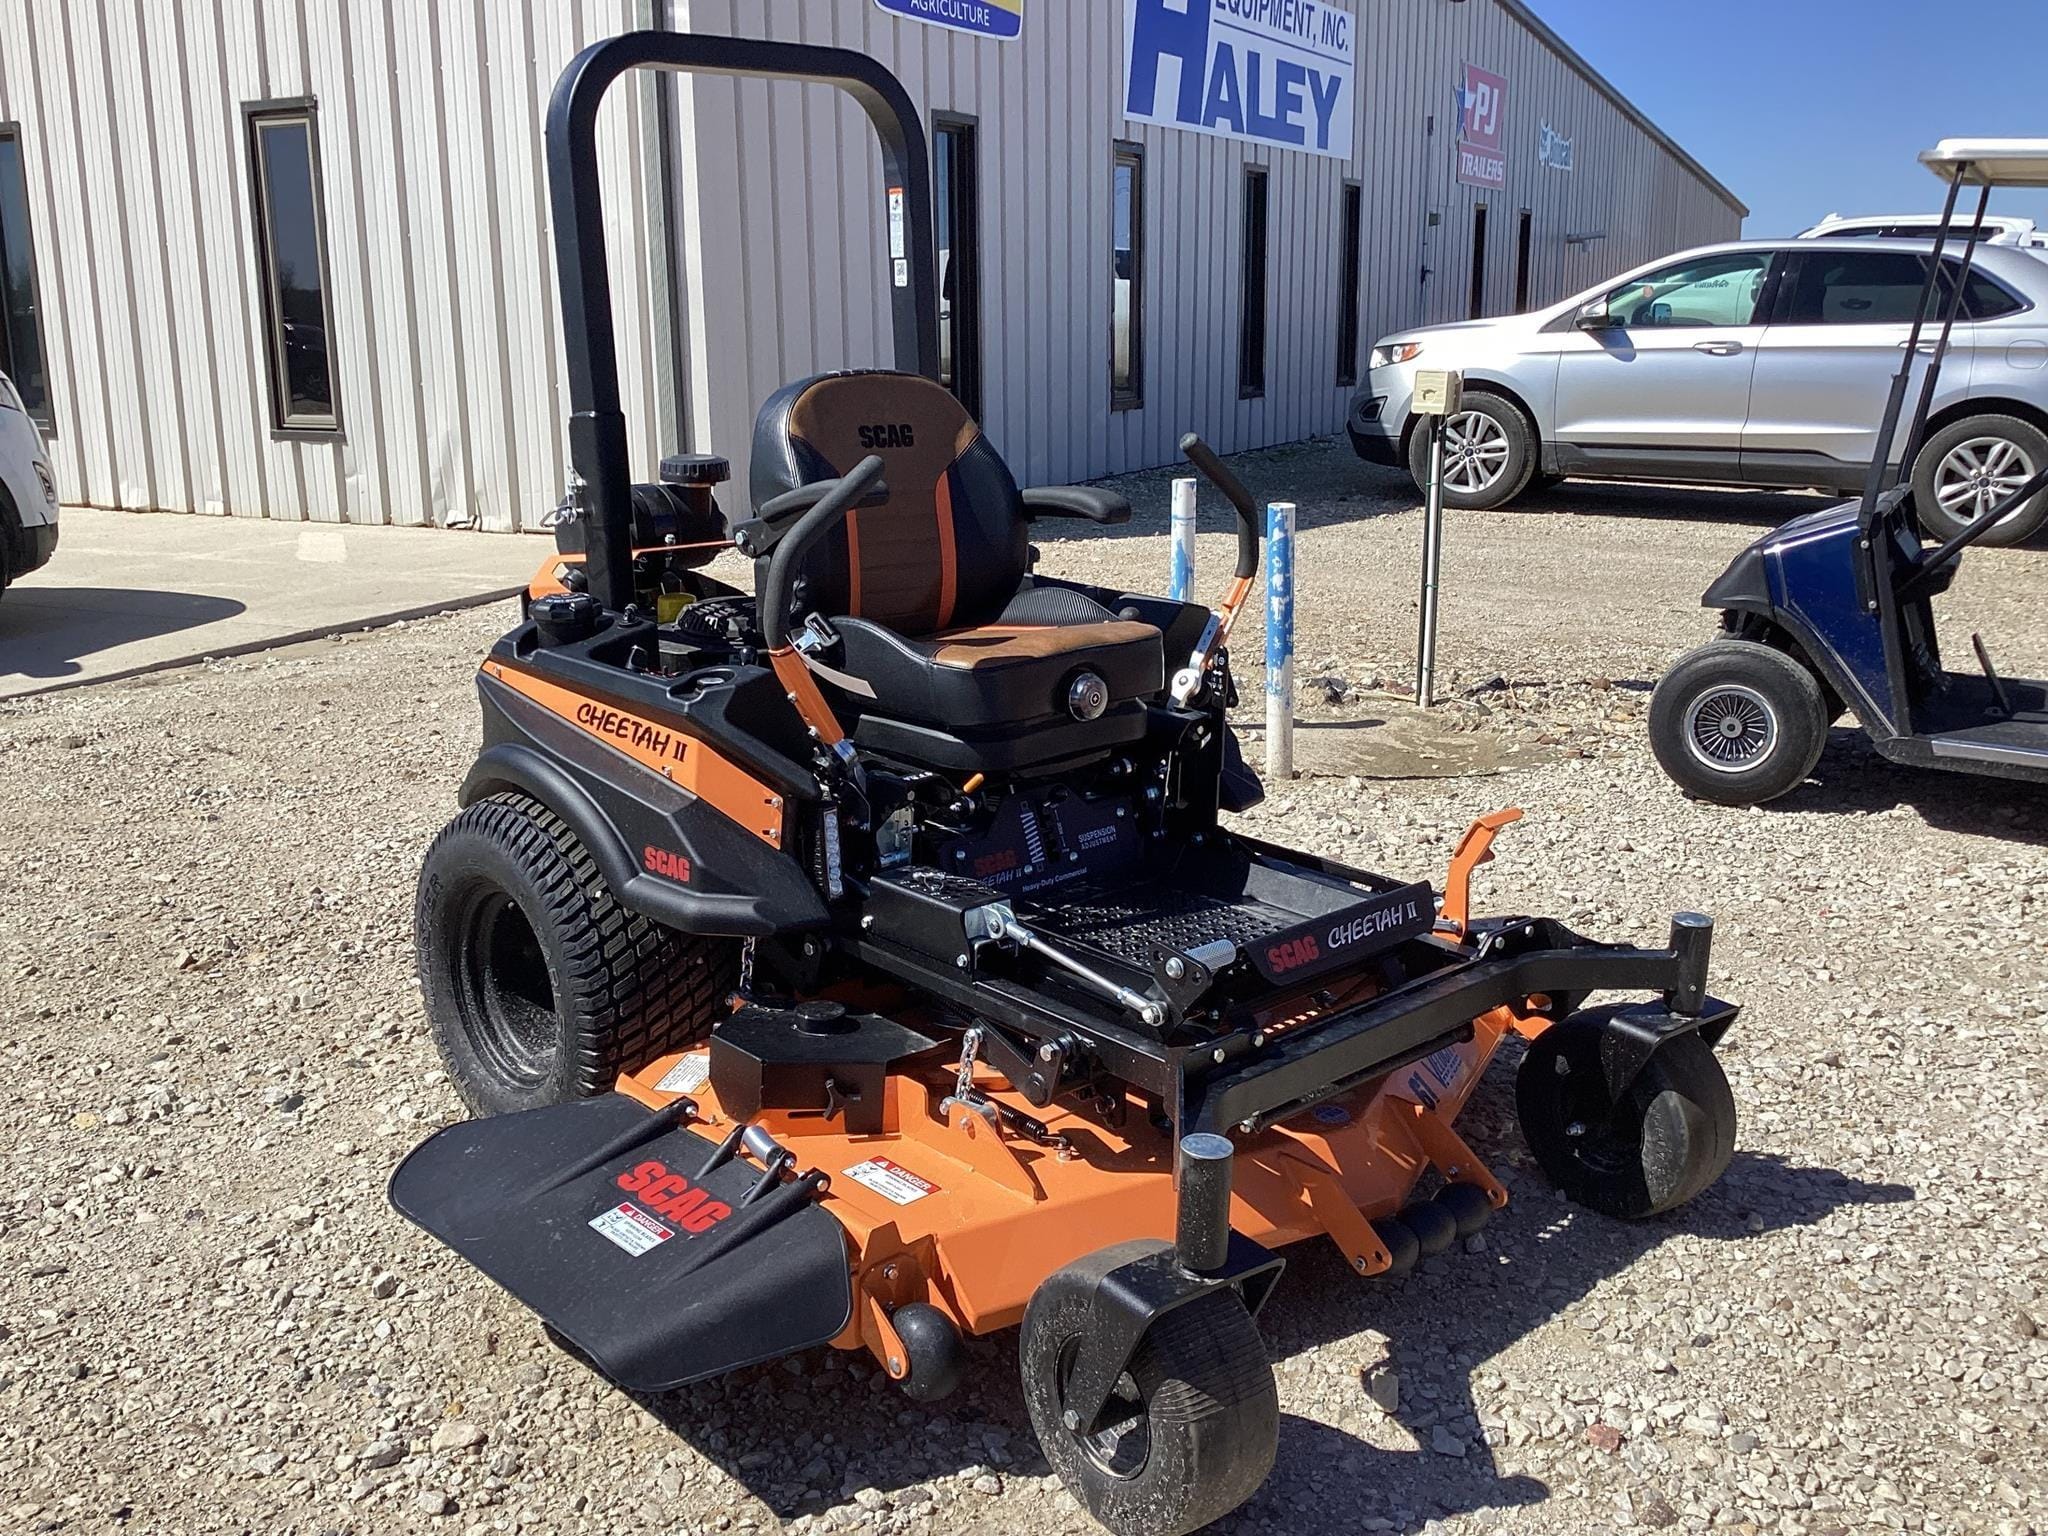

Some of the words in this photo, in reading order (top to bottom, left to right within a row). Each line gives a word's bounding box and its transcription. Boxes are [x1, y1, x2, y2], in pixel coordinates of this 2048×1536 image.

[1321, 10, 1349, 52] INC.
[1126, 0, 1342, 150] HALEY
[1473, 81, 1499, 135] PJ
[1461, 151, 1504, 181] TRAILERS
[858, 424, 914, 448] SCAG
[576, 703, 671, 757] CHEETAH
[673, 739, 689, 763] II
[1077, 825, 1117, 843] SUSPENSION
[1080, 834, 1118, 850] ADJUSTMENT
[644, 846, 691, 882] SCAG
[1022, 874, 1055, 893] Heavy-Duty
[1054, 866, 1088, 883] Commercial
[1267, 935, 1320, 973] SCAG
[1328, 903, 1402, 949] CHEETAH
[1406, 901, 1417, 920] II
[888, 1165, 933, 1191] DANGER
[616, 1160, 733, 1233] SCAG
[633, 1211, 665, 1235] DANGER
